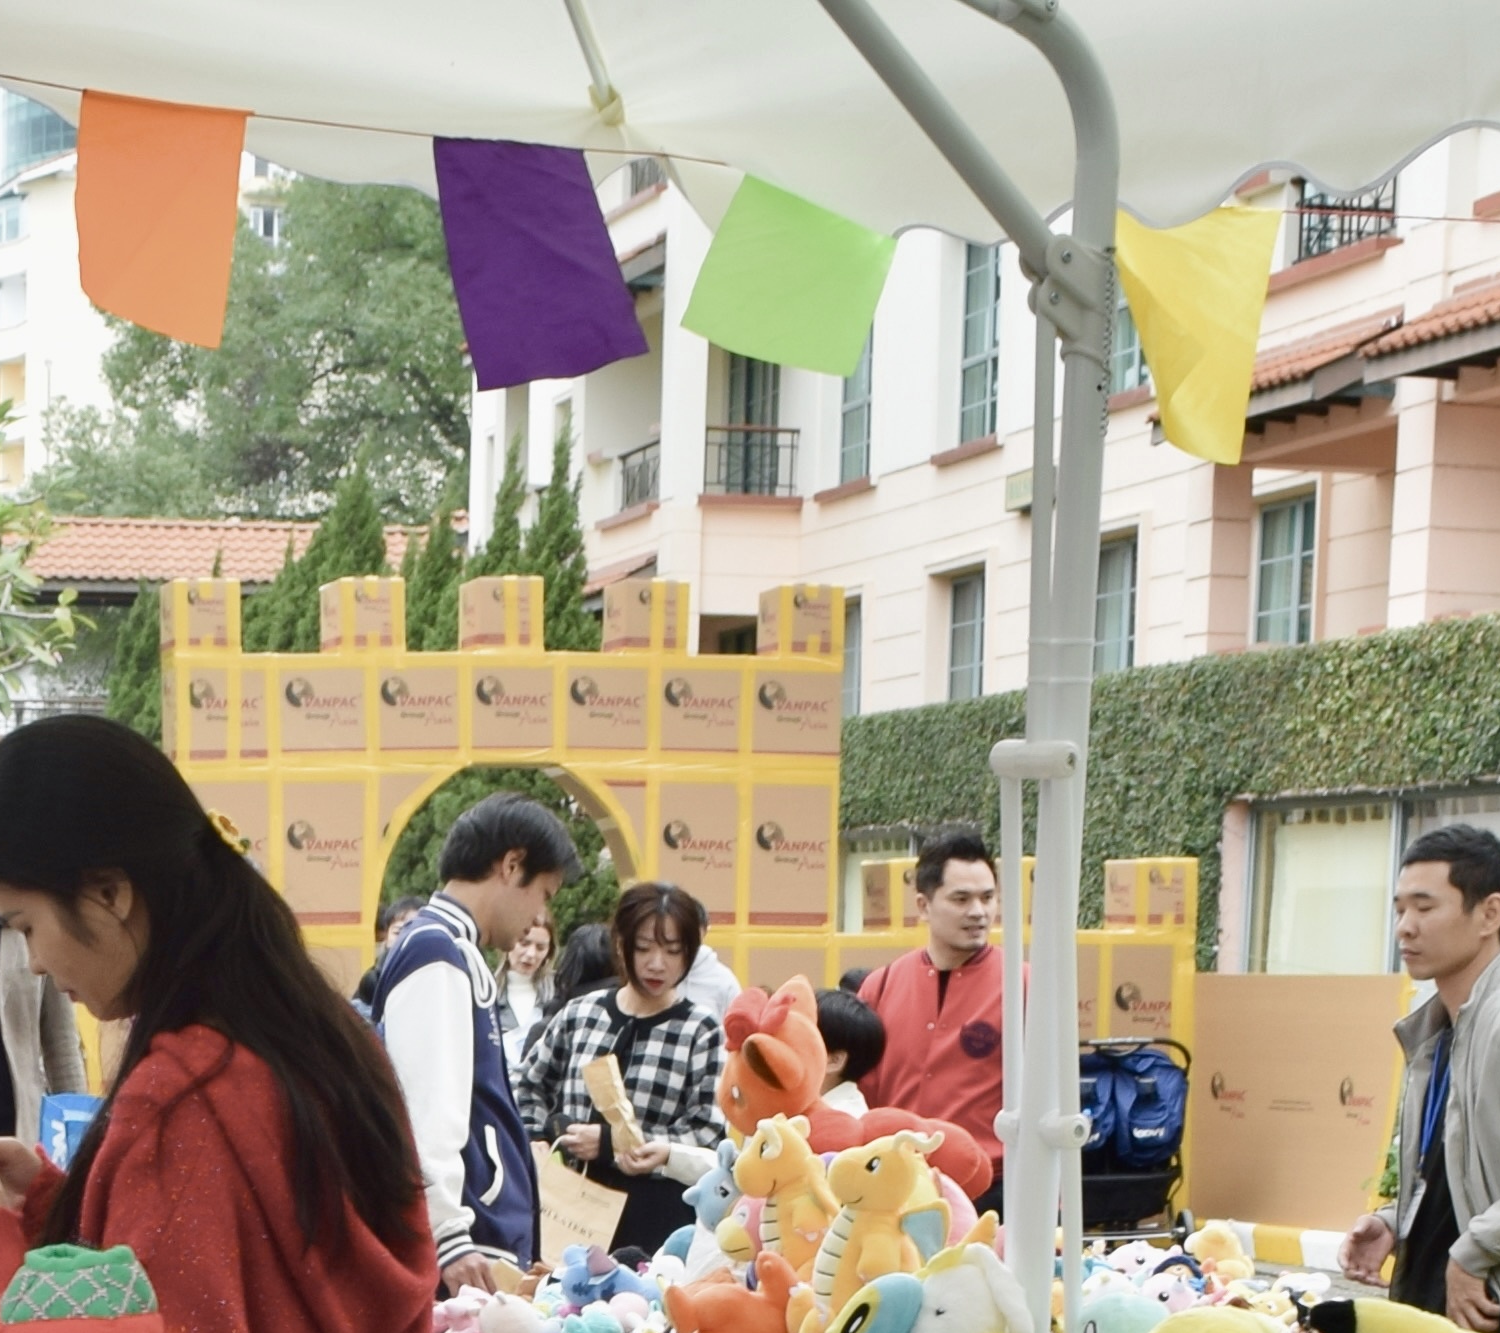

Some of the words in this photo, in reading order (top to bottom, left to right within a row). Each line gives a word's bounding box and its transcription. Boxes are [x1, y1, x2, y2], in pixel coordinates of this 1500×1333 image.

[304, 696, 357, 707] VANPAC
[400, 695, 453, 706] VANPAC
[495, 695, 547, 706] VANPAC
[589, 696, 641, 708] VANPAC
[682, 697, 735, 709] VANPAC
[776, 700, 828, 712] VANPAC
[306, 839, 358, 850] VANPAC
[681, 839, 733, 851] VANPAC
[774, 840, 826, 851] VANPAC
[1132, 1001, 1171, 1013] VANPA
